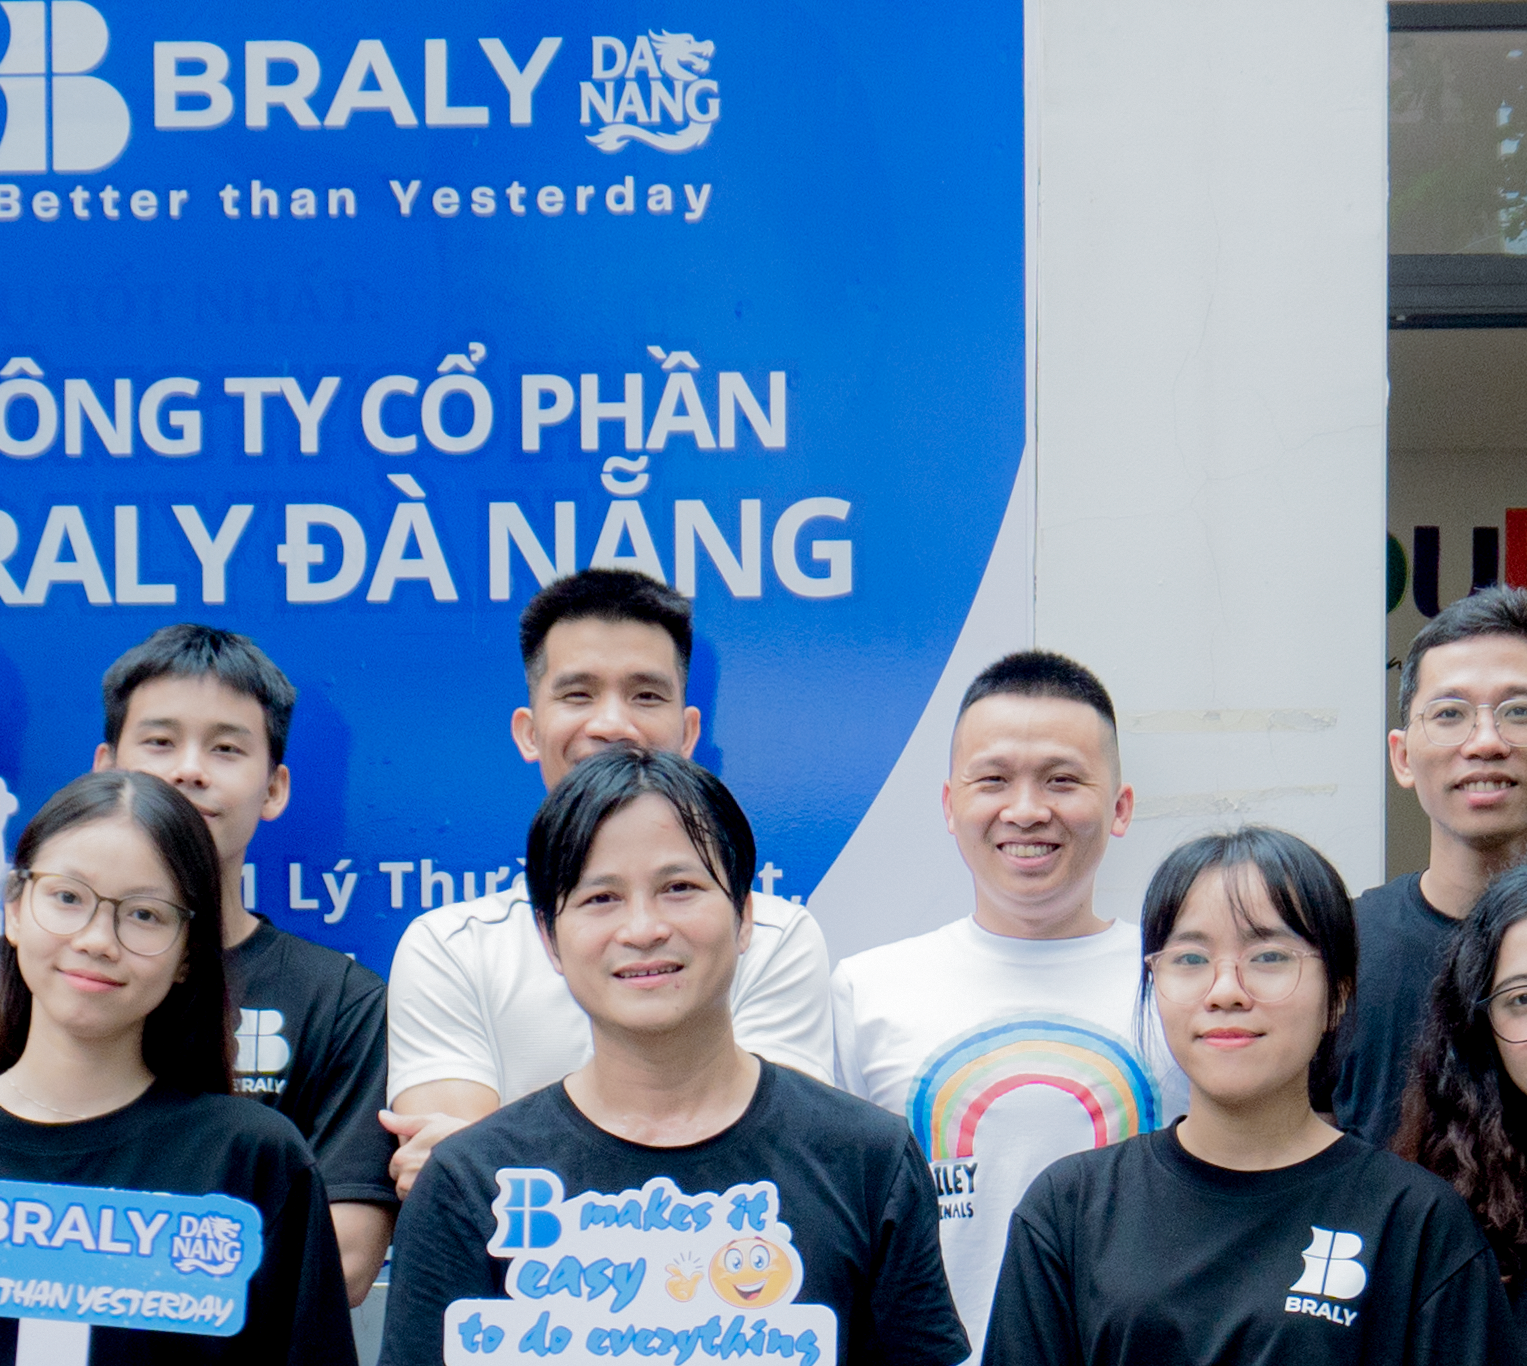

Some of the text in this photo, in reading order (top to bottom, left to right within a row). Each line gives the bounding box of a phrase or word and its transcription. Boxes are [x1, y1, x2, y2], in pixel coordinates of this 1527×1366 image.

[154, 37, 563, 128] BRALY
[579, 79, 721, 125] NANG
[220, 181, 356, 217] than
[389, 175, 712, 221] Yesterday
[225, 376, 341, 454] TY
[361, 342, 493, 454] CỔ
[522, 345, 787, 451] PHẦN
[277, 473, 458, 603] ĐÀ
[489, 456, 853, 600] NẴNG
[289, 859, 358, 924] Lý
[934, 1163, 978, 1196] ILEY
[580, 1187, 714, 1233] makes
[727, 1190, 769, 1232] it
[172, 1236, 242, 1264] NANG
[73, 1283, 235, 1328] YESTERDAY
[516, 1255, 647, 1314] easy
[458, 1311, 505, 1355] to
[518, 1310, 573, 1357] do
[1284, 1296, 1358, 1327] BRALY
